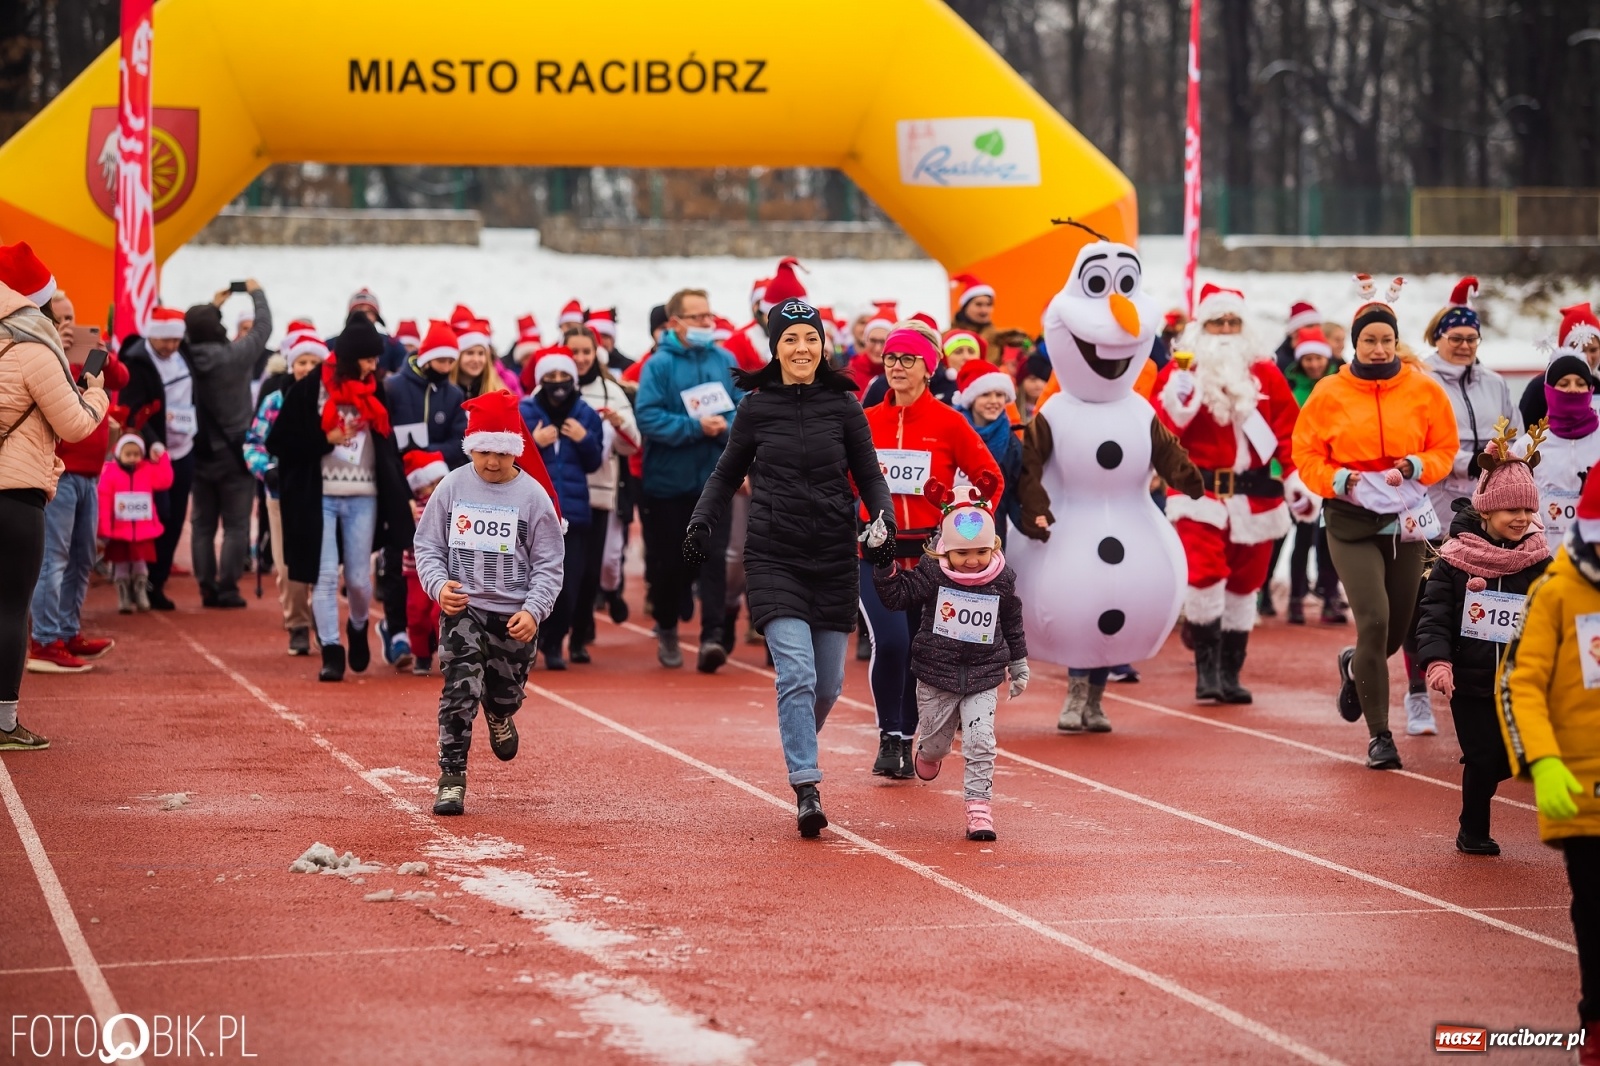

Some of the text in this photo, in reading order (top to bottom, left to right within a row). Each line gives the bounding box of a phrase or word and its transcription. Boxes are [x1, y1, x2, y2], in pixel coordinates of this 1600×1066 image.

[348, 49, 768, 95] MIASTO RACIBÓRZ
[889, 465, 925, 481] 087
[473, 519, 511, 538] 085
[957, 608, 992, 628] 009
[1487, 608, 1521, 629] 185
